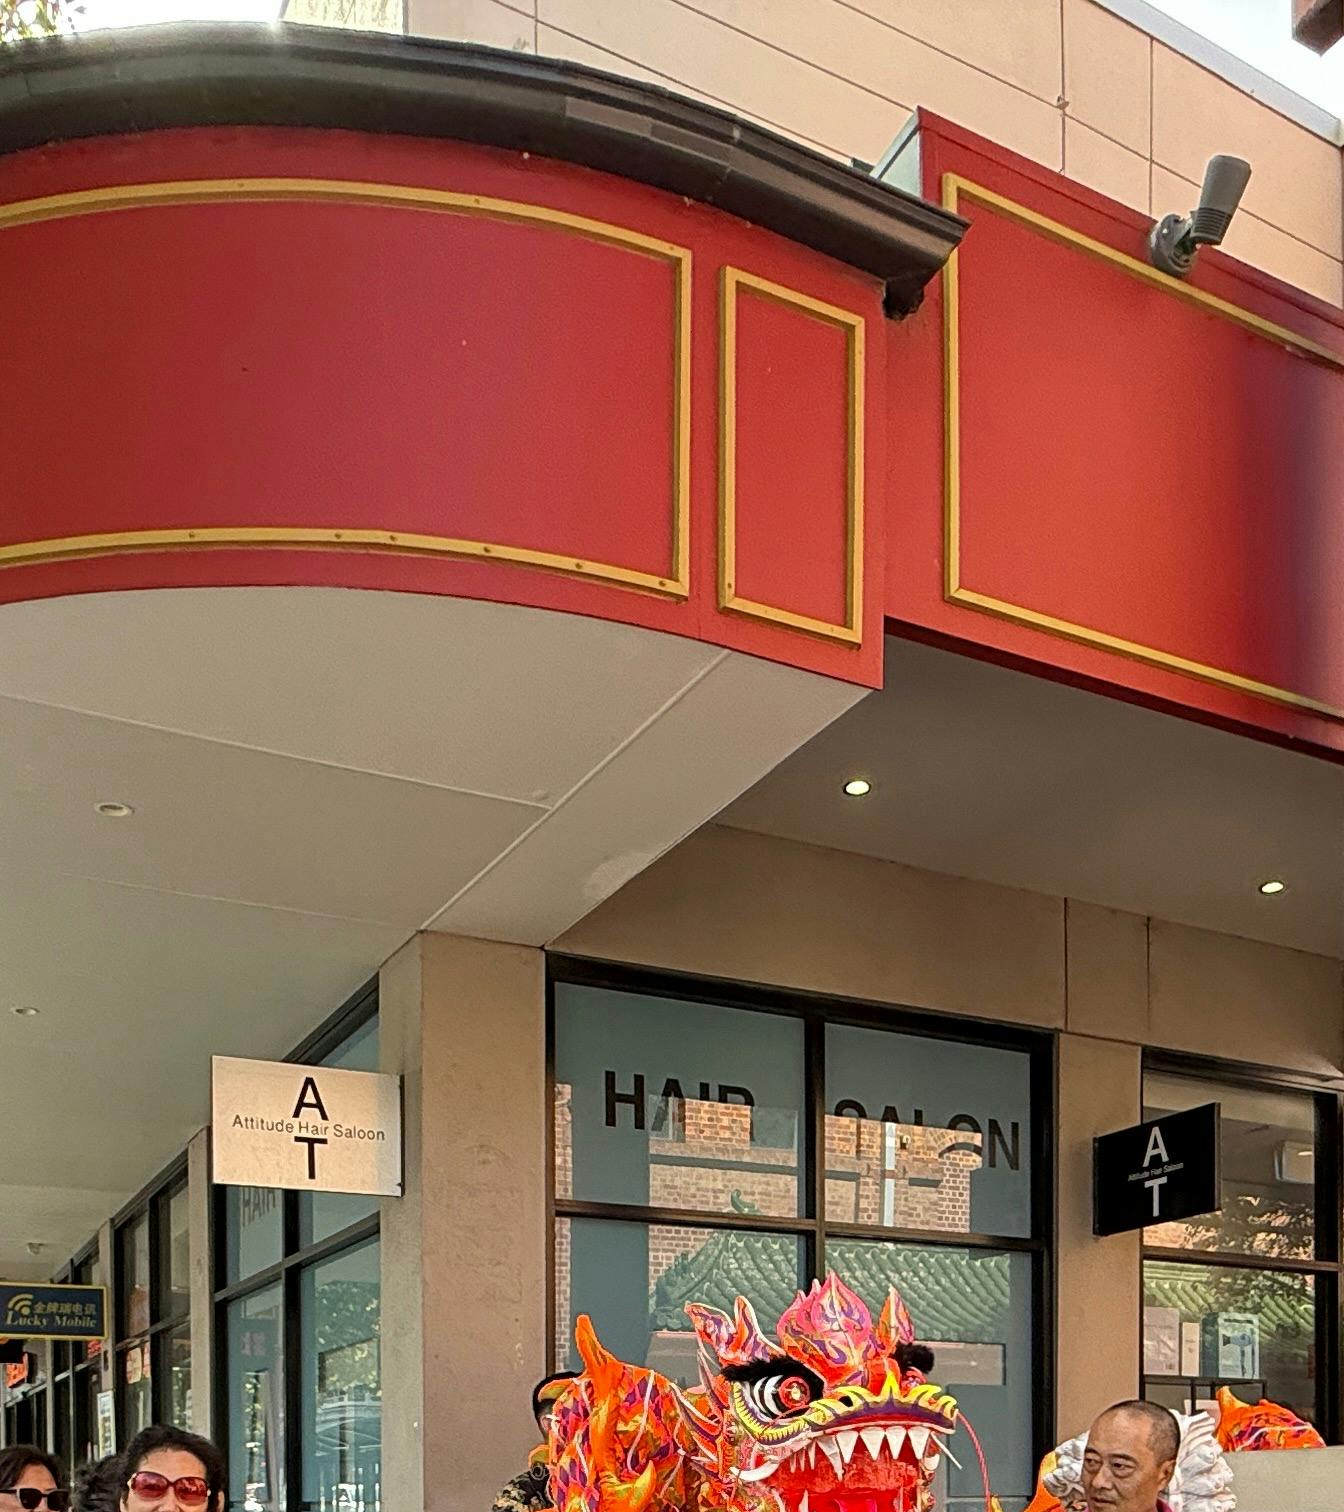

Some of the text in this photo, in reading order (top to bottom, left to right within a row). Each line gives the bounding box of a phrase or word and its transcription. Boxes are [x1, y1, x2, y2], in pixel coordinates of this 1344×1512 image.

[292, 1077, 329, 1121] A
[604, 1070, 755, 1141] HAIR
[232, 1114, 386, 1141] Attitude Hair Saloon
[832, 1099, 1020, 1171] SALON
[1142, 1126, 1169, 1167] A
[294, 1136, 328, 1179] T
[1144, 1175, 1168, 1217] T
[6, 1311, 97, 1328] Lucky Mobile
